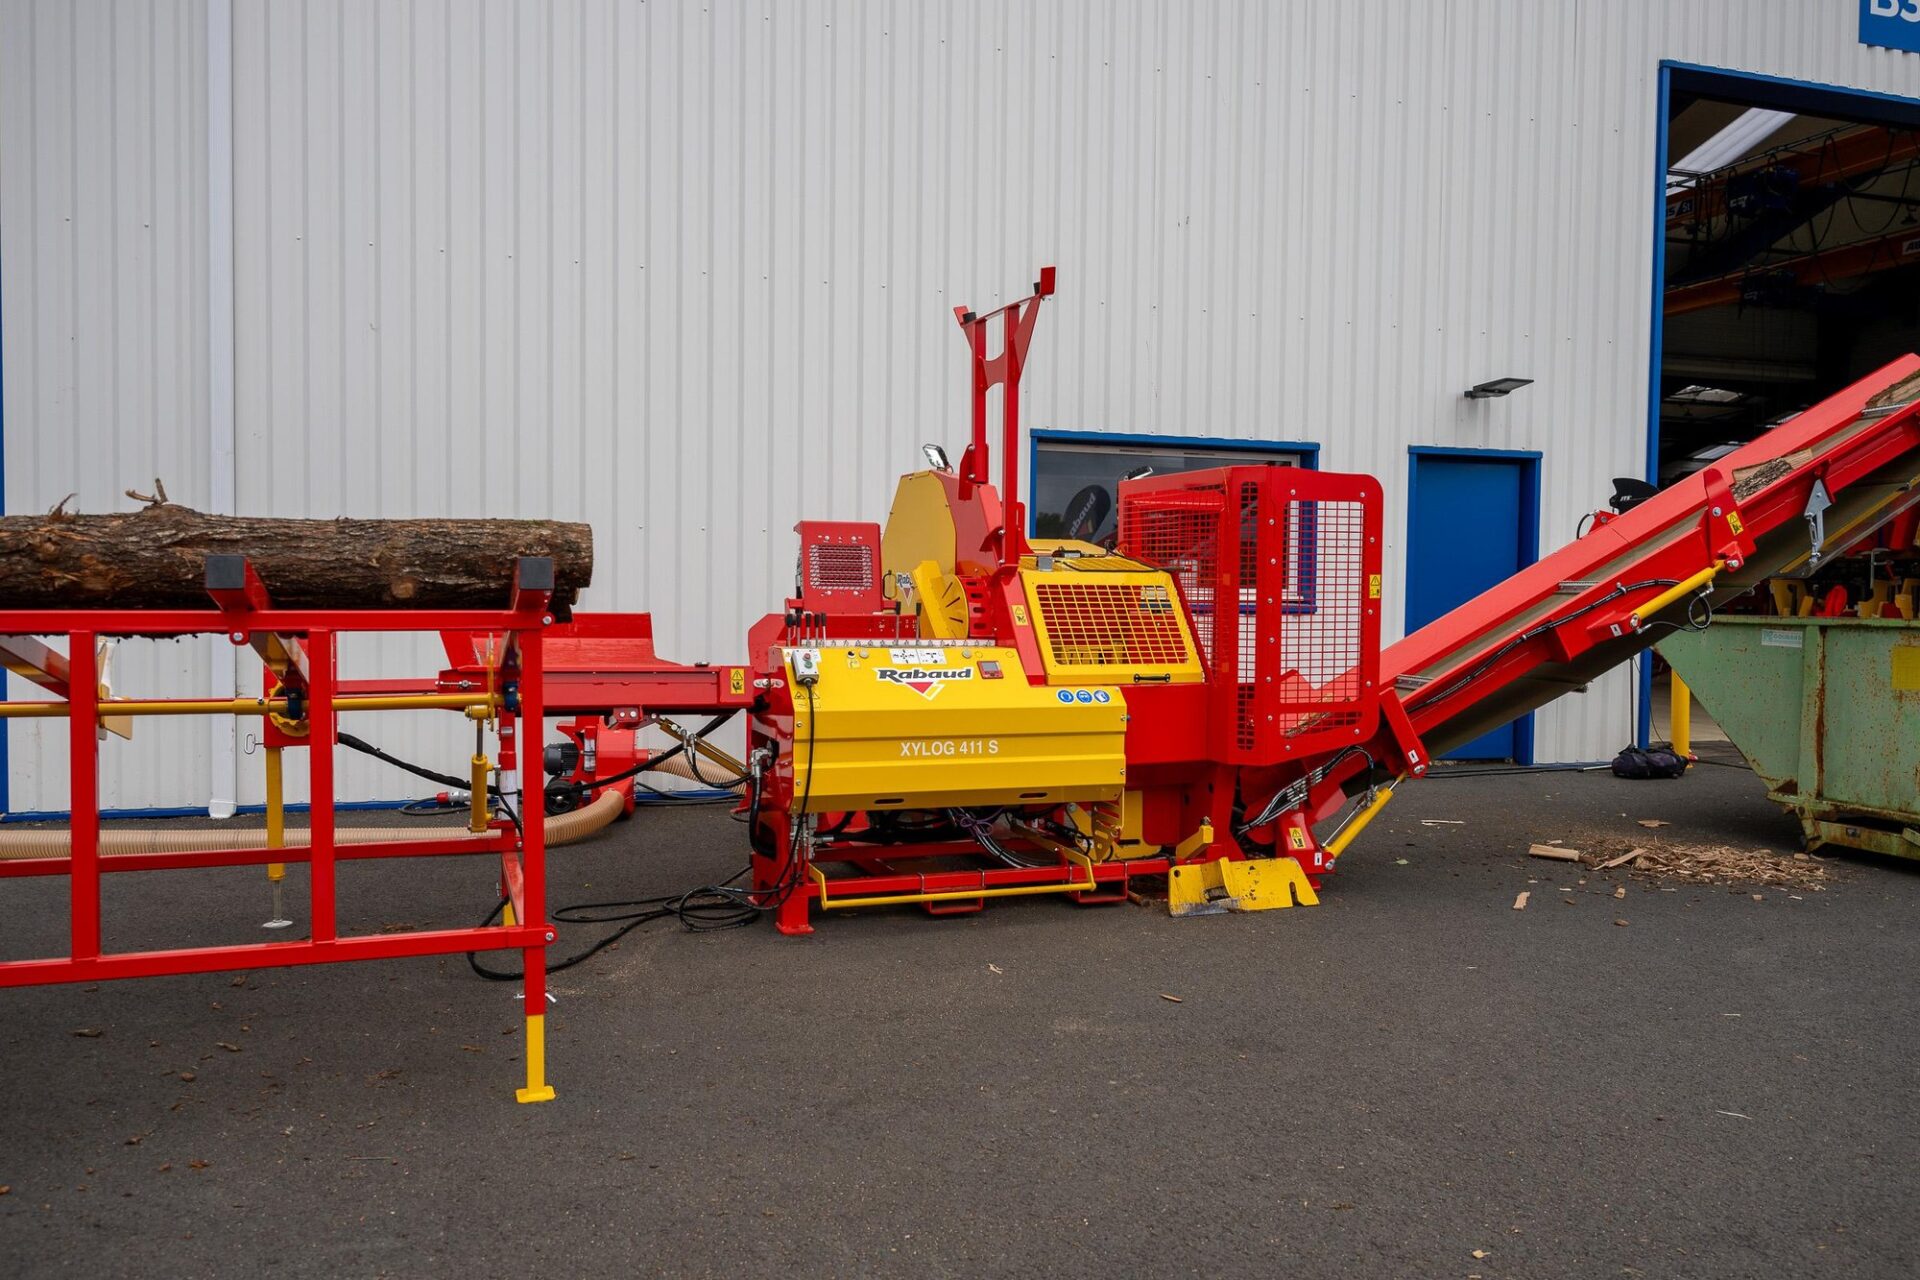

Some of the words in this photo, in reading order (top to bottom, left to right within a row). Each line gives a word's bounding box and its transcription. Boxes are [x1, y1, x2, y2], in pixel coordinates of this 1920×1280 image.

[1070, 492, 1096, 538] abaud
[878, 669, 971, 683] Rabaud
[900, 741, 955, 756] XYLOG
[960, 740, 982, 754] 411
[988, 740, 999, 754] S
